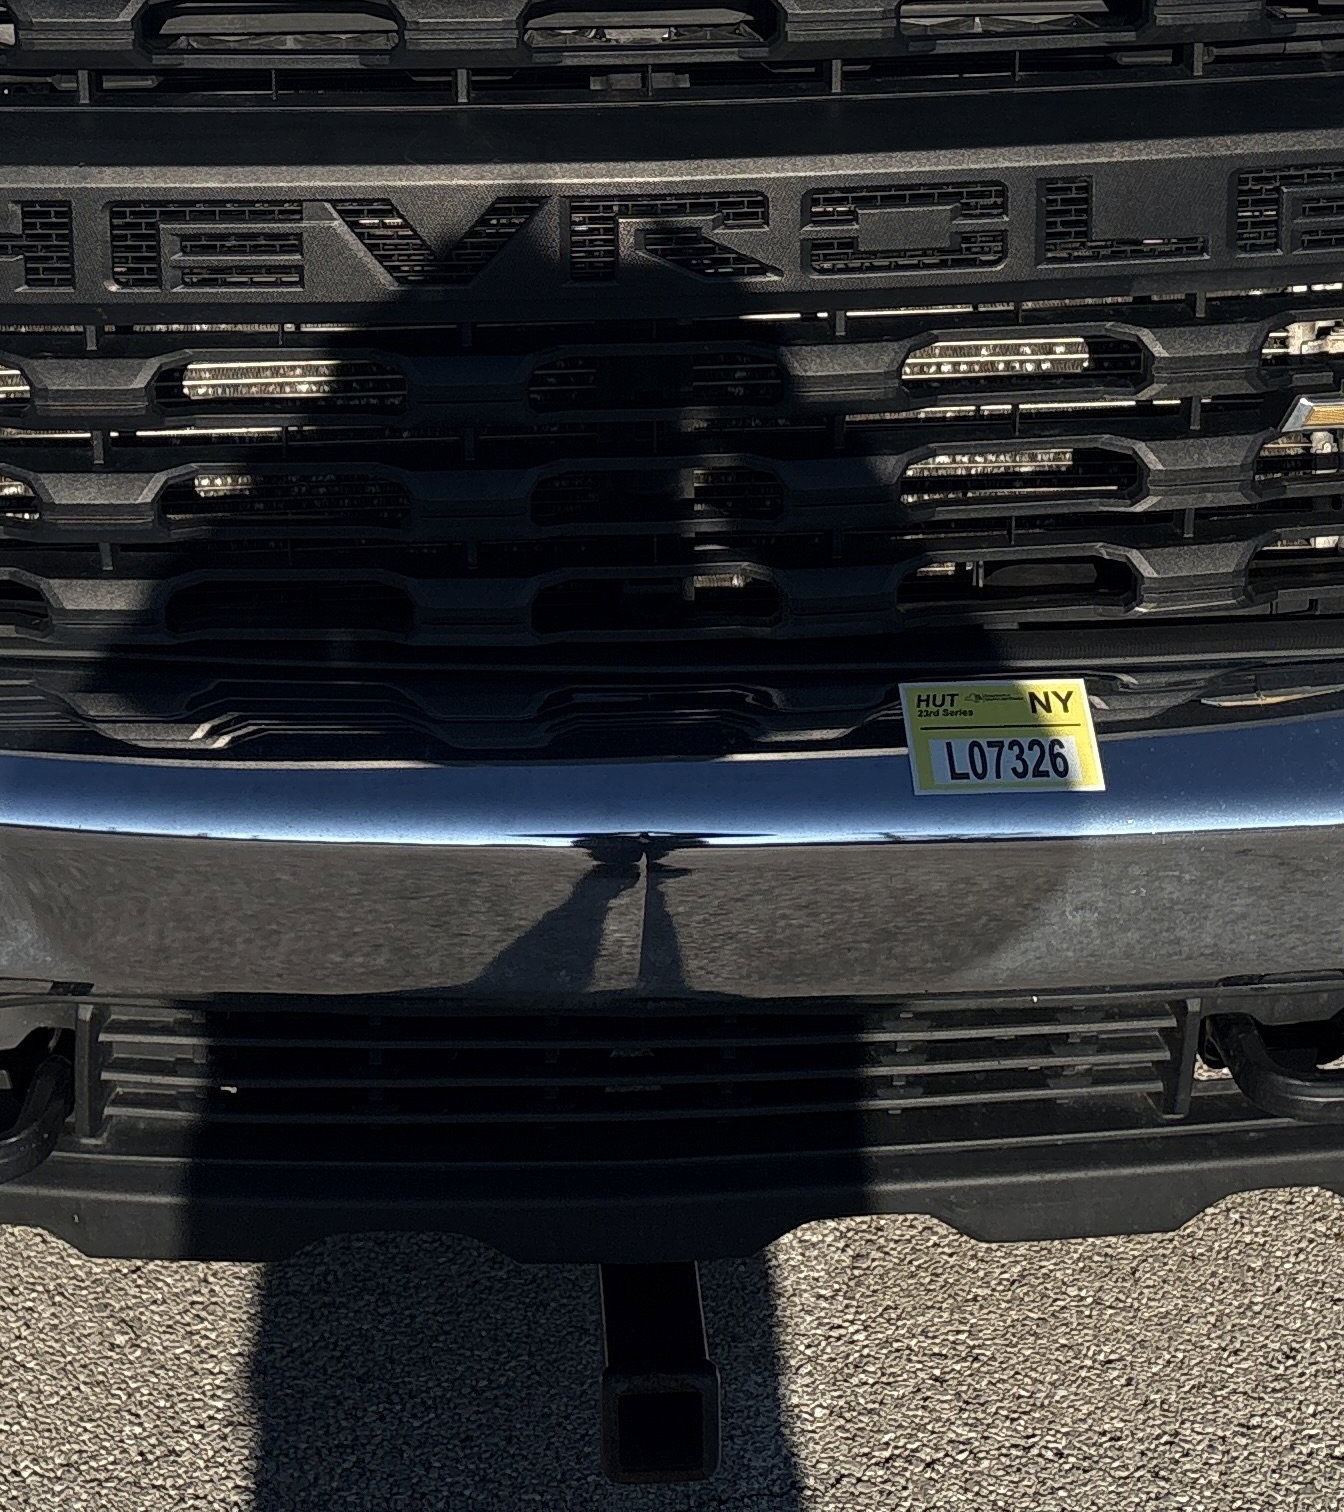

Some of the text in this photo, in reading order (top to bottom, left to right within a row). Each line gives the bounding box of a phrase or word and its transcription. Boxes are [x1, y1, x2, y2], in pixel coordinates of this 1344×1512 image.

[916, 693, 959, 708] HUT
[1028, 690, 1074, 714] NY
[942, 708, 974, 717] Series
[945, 738, 1070, 781] L07326
